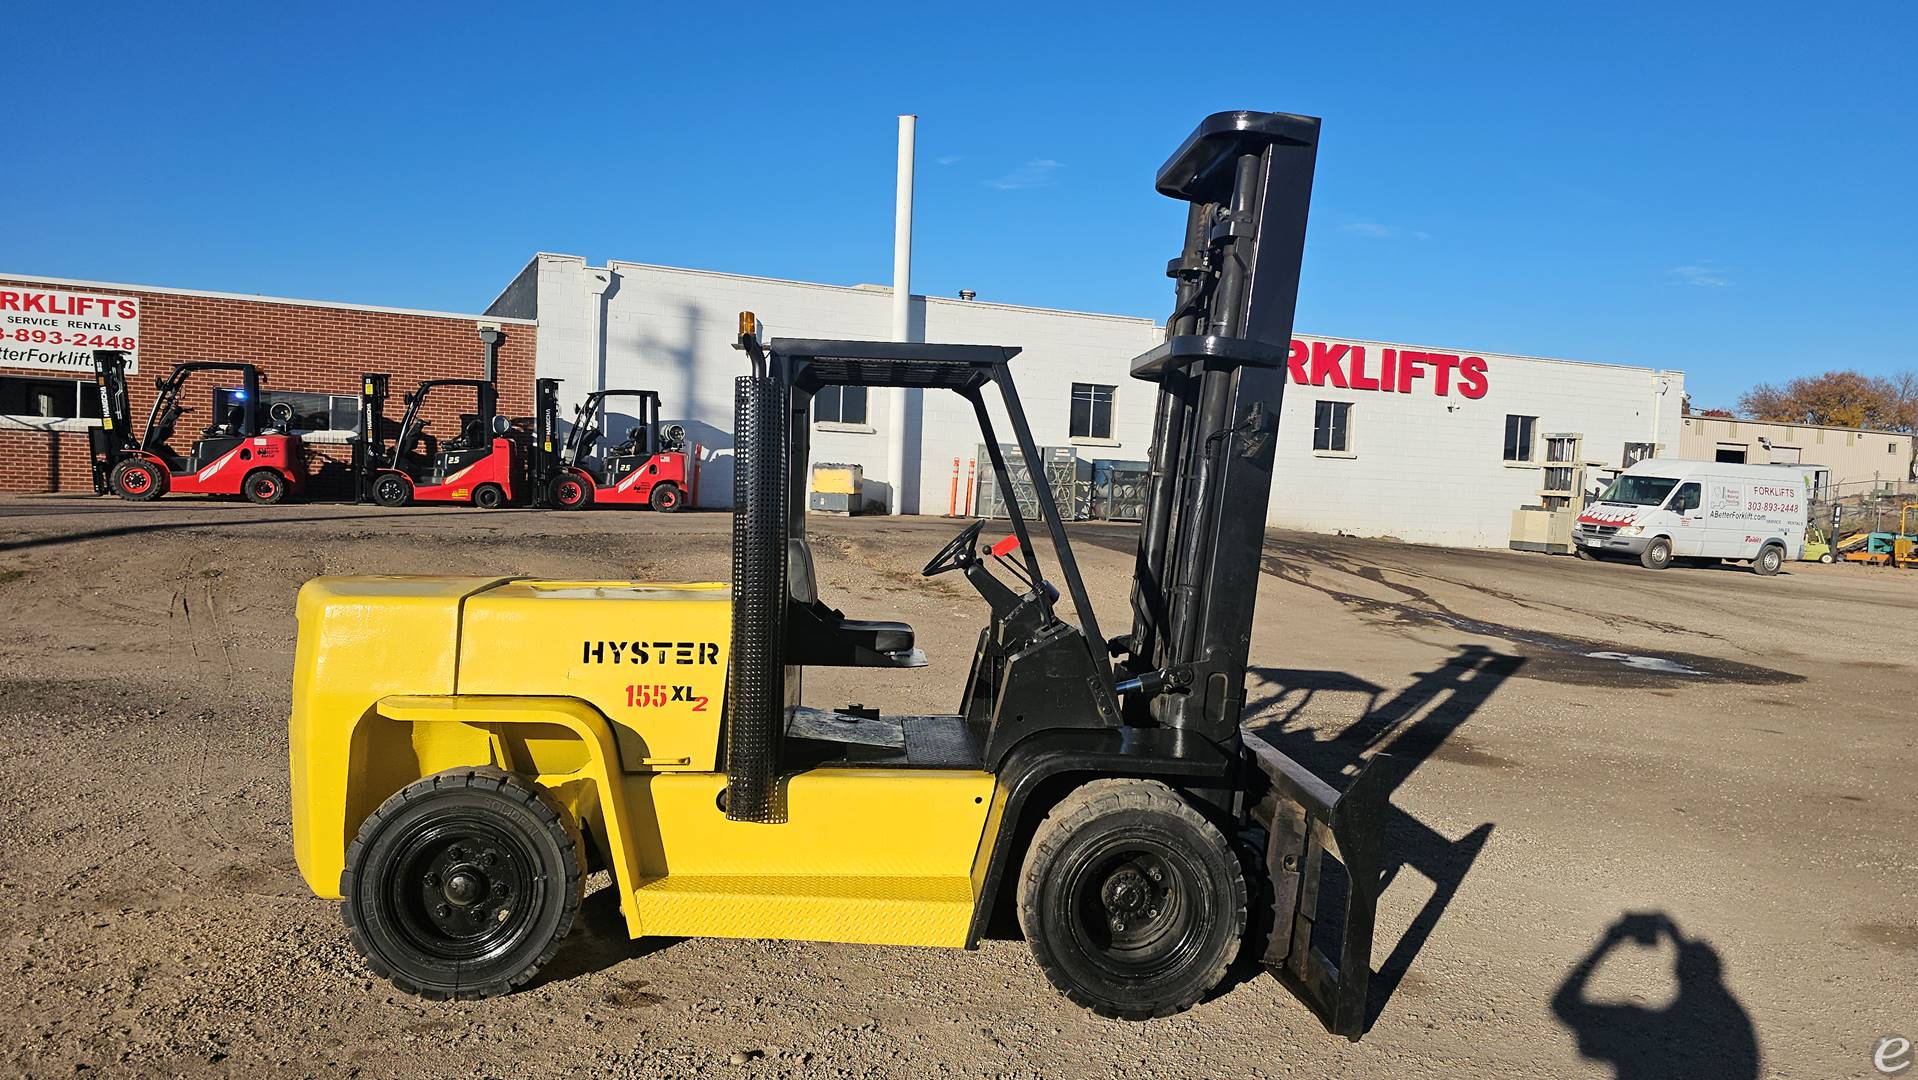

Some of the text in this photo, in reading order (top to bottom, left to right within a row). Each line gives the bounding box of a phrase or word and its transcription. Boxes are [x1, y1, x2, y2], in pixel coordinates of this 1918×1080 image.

[0, 291, 137, 320] RKLIFTS
[7, 315, 122, 332] SERVICE RENTALS
[1287, 339, 1489, 400] RKLIFTS
[1753, 486, 1795, 498] FORKLIFTS
[583, 641, 720, 666] HYSTER
[625, 685, 668, 708] 155
